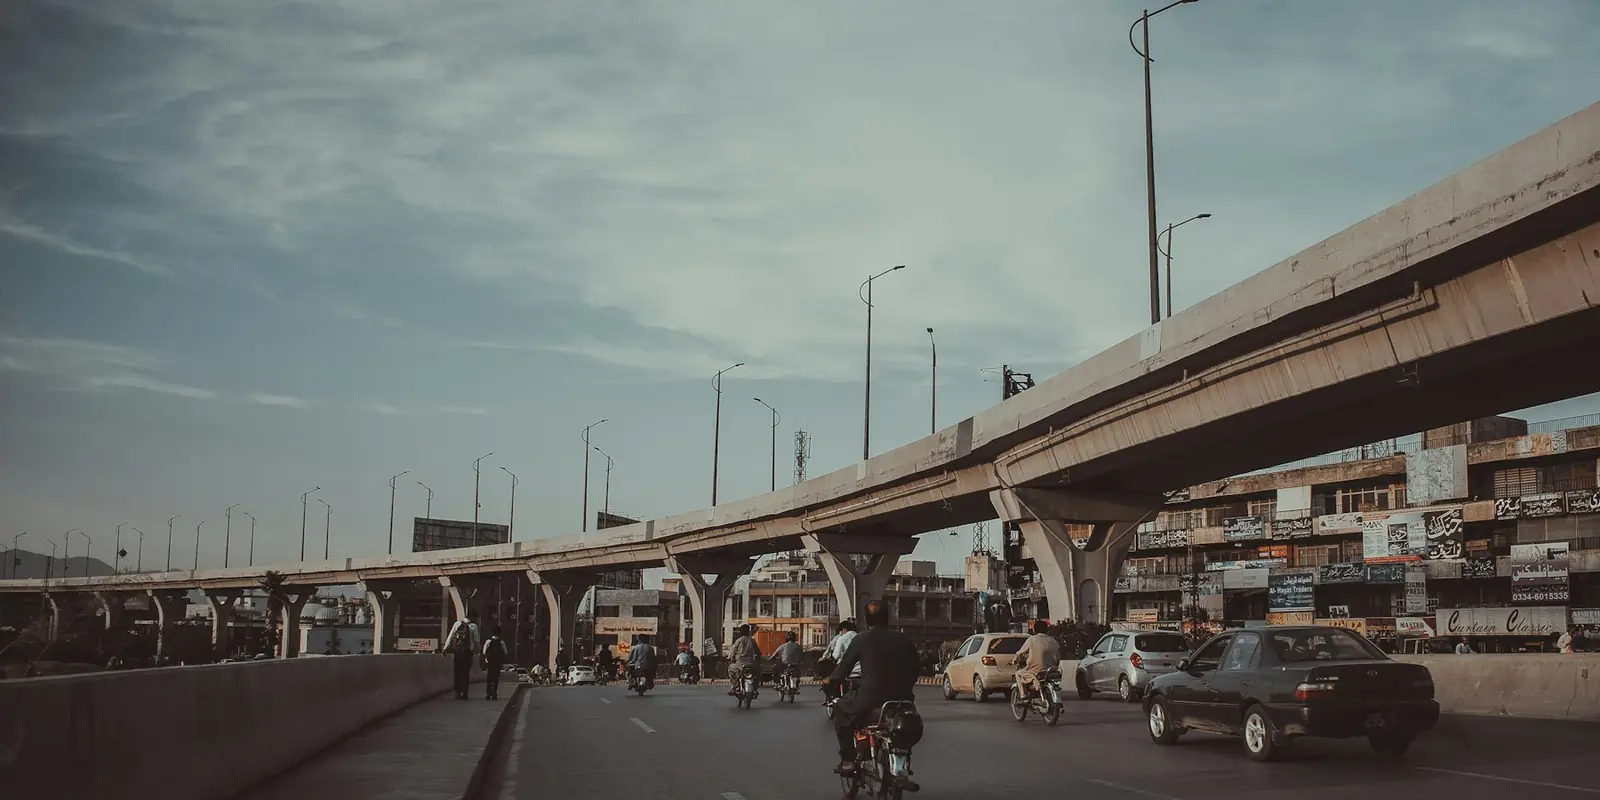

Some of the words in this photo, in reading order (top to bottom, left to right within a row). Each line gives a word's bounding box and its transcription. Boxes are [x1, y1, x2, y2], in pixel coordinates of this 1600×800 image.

[1427, 509, 1463, 539] جنگ
[1513, 592, 1568, 600] 0334-6015335
[1400, 621, 1424, 629] MASTER
[1448, 610, 1496, 632] Curtain
[1506, 609, 1552, 632] Classic
